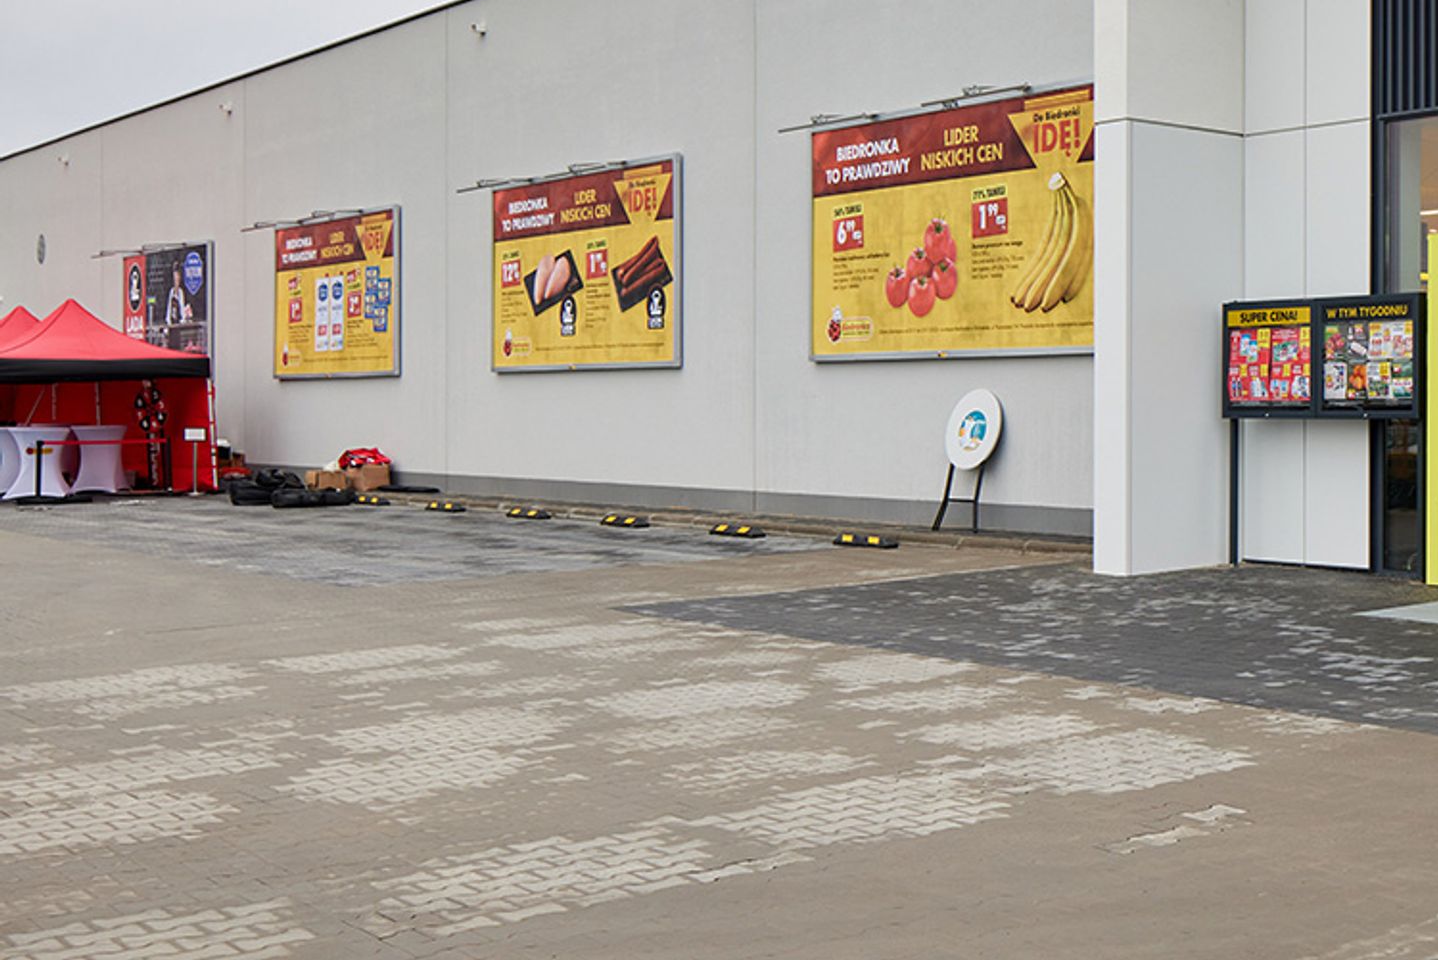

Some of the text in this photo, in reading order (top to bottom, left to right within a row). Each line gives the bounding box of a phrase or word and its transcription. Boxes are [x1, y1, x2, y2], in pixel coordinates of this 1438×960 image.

[943, 125, 979, 147] LIDER
[1032, 117, 1080, 157] IDĘ!
[836, 137, 900, 162] BIEDRONKA
[920, 143, 1004, 171] NISKICH CEN
[825, 157, 911, 184] TO PRAWDZIWY
[1239, 311, 1267, 324] SUPER
[1359, 304, 1409, 318] TYGODNIU
